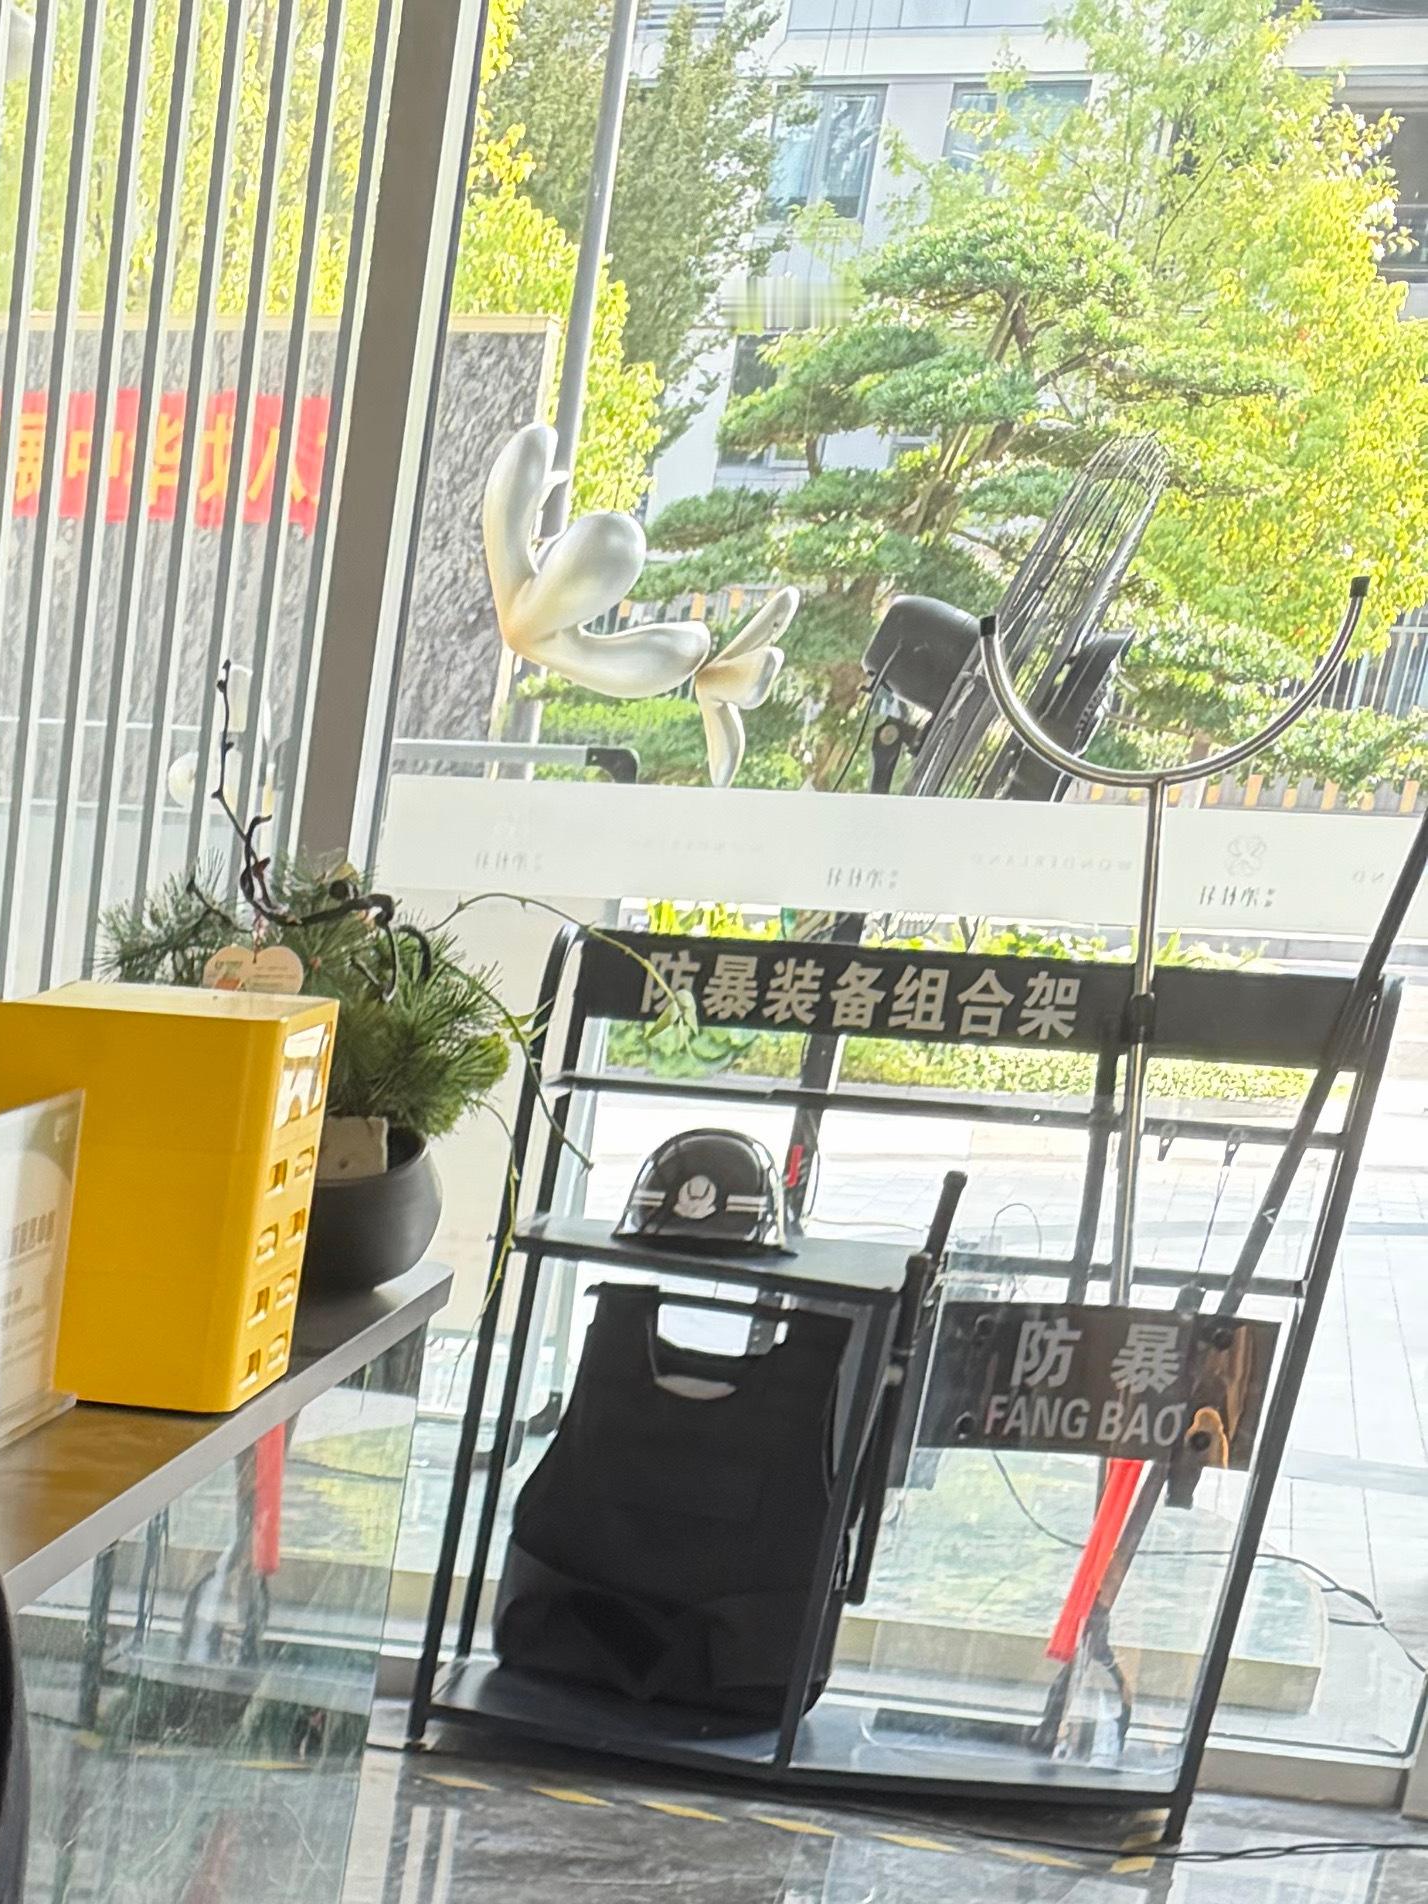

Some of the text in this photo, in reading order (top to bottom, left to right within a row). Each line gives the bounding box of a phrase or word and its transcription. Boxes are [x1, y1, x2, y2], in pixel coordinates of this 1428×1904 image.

[641, 950, 1081, 1041] 防暴装备组合架
[984, 1395, 1187, 1447] FANG BAO
